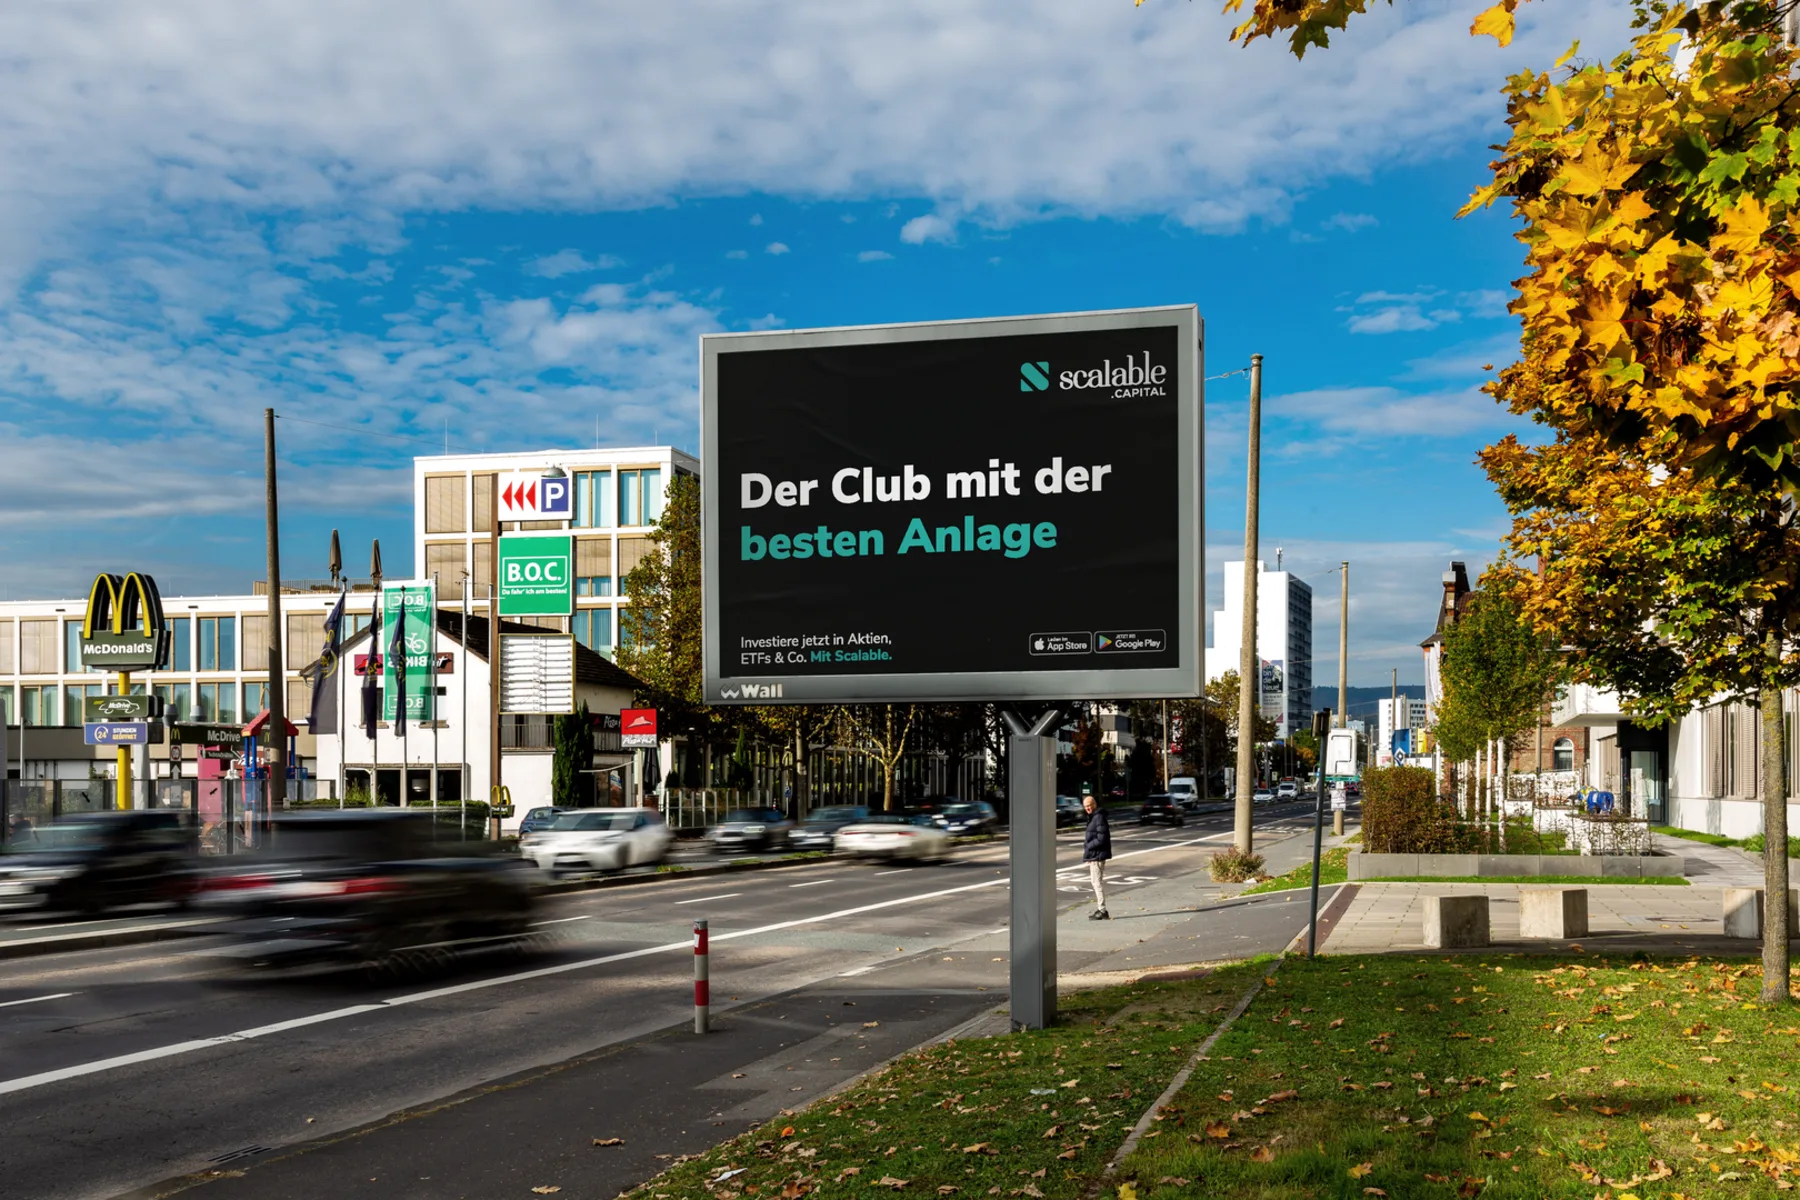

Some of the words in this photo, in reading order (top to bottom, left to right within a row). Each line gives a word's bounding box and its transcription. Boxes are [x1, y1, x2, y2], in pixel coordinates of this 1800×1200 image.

[1059, 350, 1167, 390] scalable
[1111, 387, 1166, 399] .CAPITAL
[741, 473, 818, 508] Der
[832, 464, 931, 504] Club
[947, 459, 1020, 499] mit
[1035, 457, 1112, 494] der
[545, 482, 564, 509] P
[741, 525, 884, 560] besten
[897, 515, 1057, 559] Anlage
[507, 561, 562, 582] B.O.C.
[83, 643, 153, 655] McDonald's
[741, 635, 799, 648] Investiere
[801, 634, 830, 649] jetzt
[833, 633, 844, 645] in
[848, 632, 892, 645] Aktien,
[1047, 642, 1064, 651] App
[1065, 641, 1087, 650] Store
[1115, 639, 1143, 649] Google
[1144, 639, 1161, 648] Play
[741, 652, 771, 665] ETFs
[774, 652, 785, 664] &
[787, 651, 807, 663] Co.
[810, 650, 832, 662] Mit
[835, 648, 893, 662] Scalable.
[741, 683, 783, 698] Wall
[207, 729, 241, 742] McDrive
